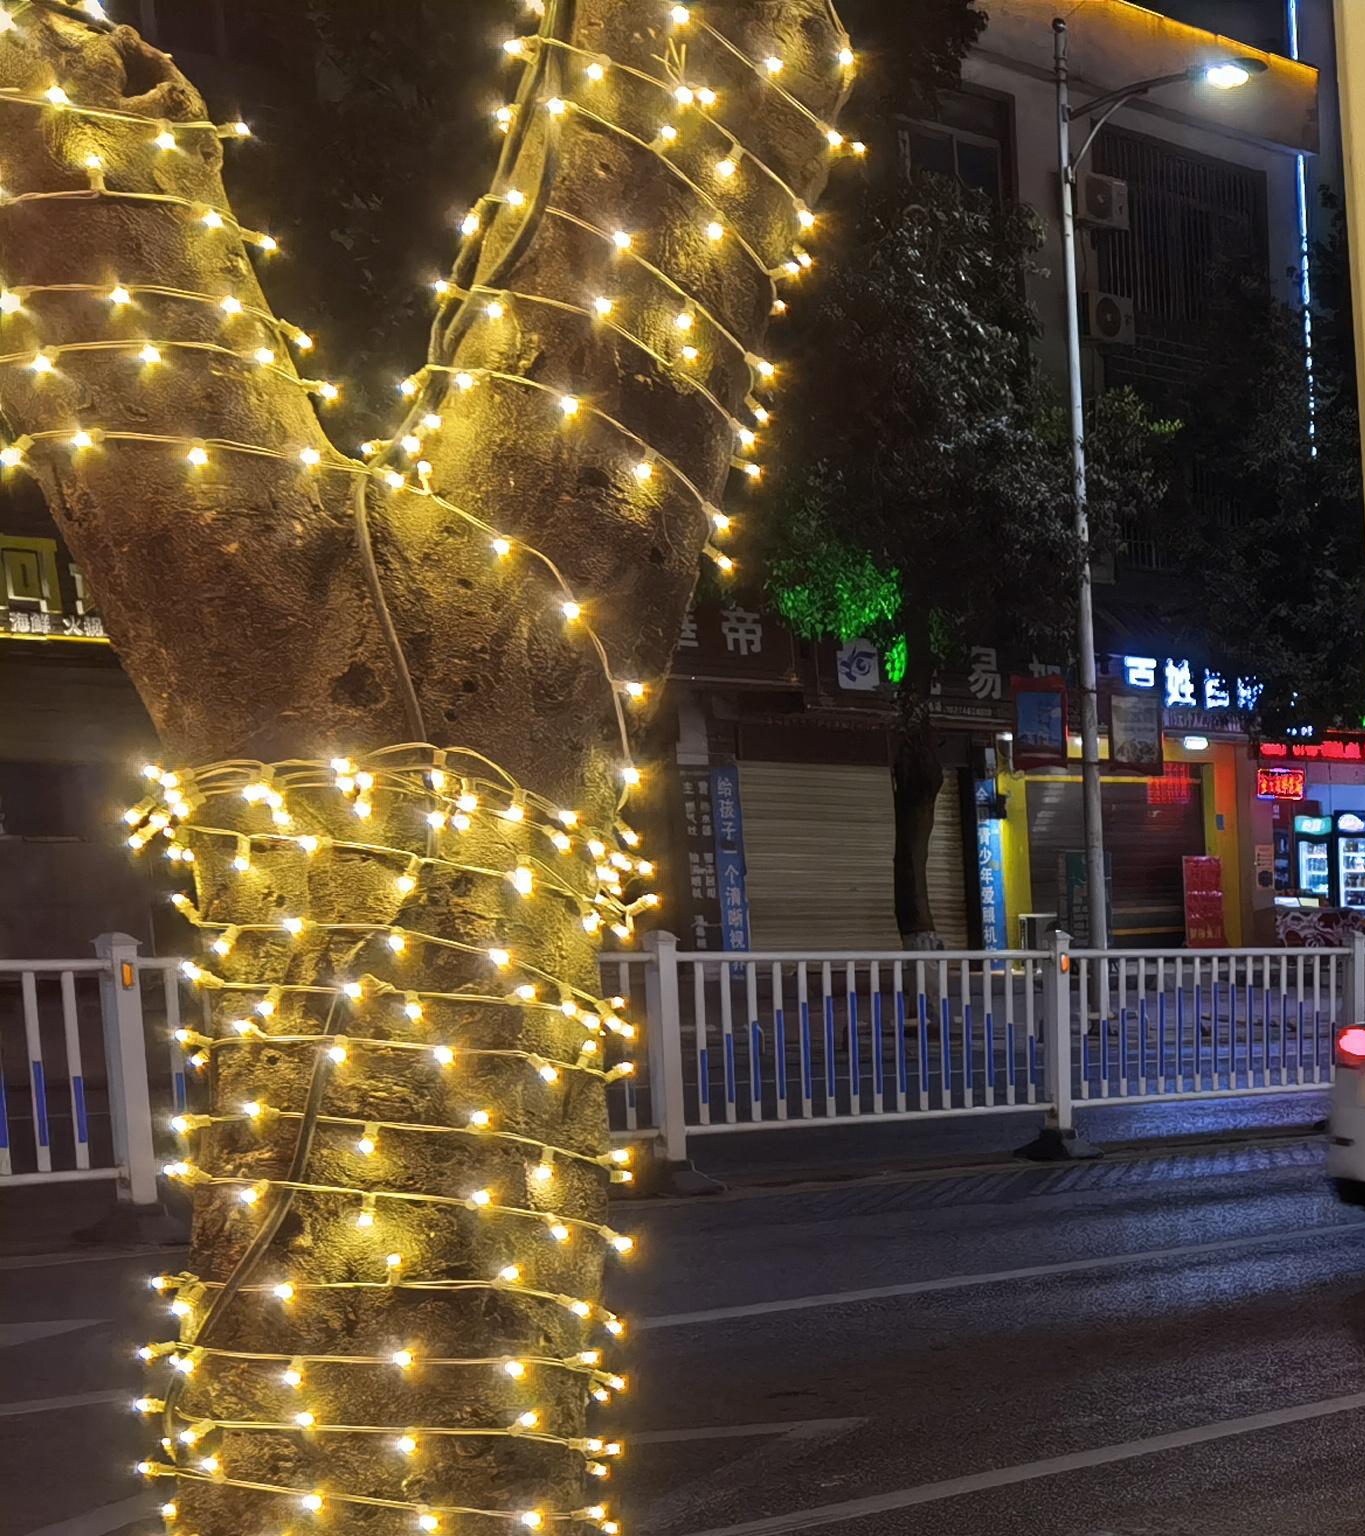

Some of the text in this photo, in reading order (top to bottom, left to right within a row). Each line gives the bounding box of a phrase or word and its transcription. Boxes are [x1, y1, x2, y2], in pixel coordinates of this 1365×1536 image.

[976, 787, 998, 962] 全国青少年爱眼机
